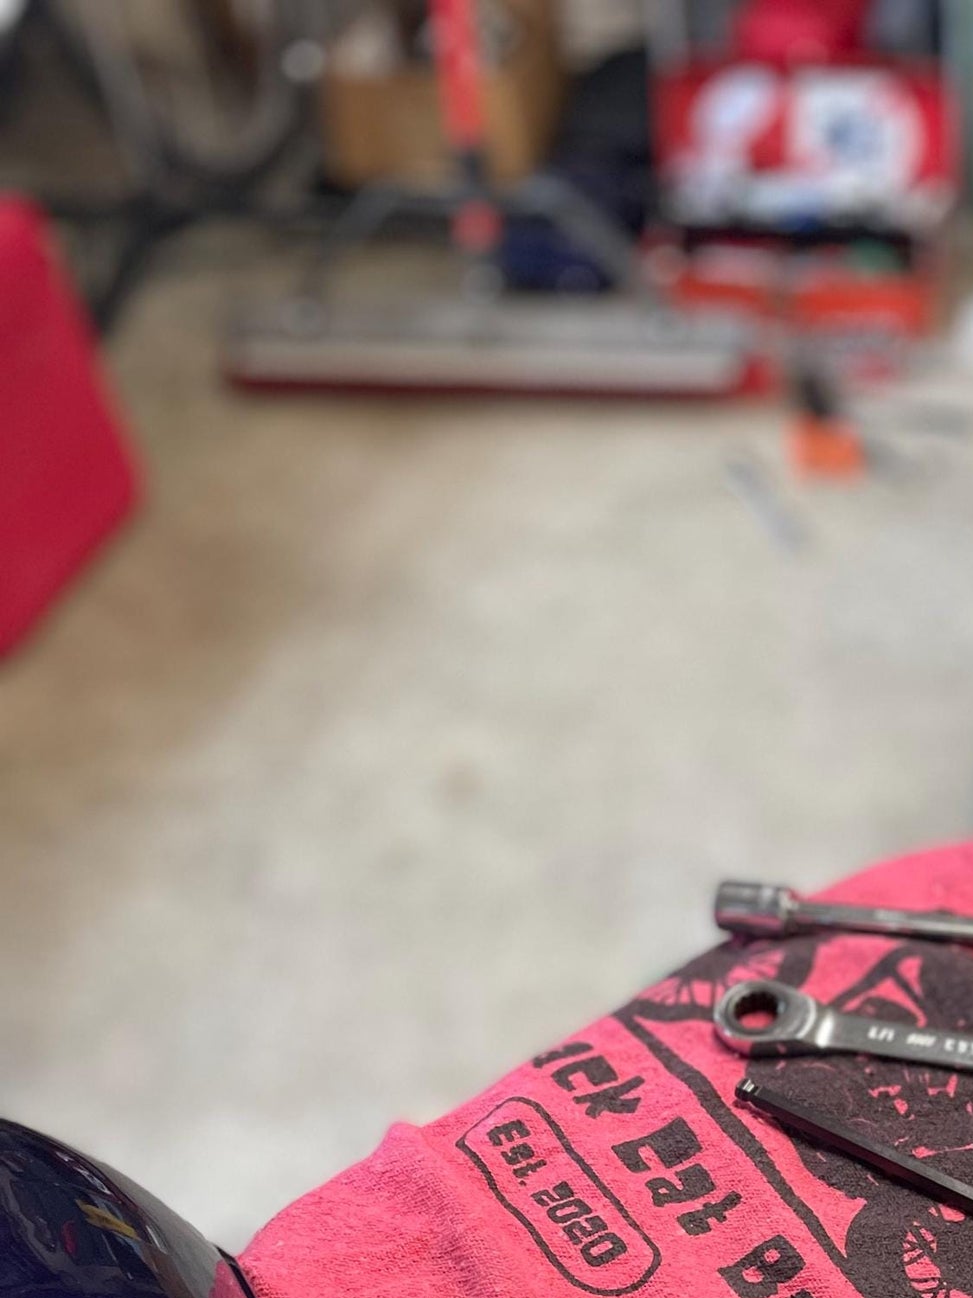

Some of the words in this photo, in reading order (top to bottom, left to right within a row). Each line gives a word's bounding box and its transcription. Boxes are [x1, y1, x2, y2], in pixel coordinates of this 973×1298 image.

[486, 1119, 548, 1186] Est.
[530, 1180, 628, 1267] 2020
[611, 1117, 742, 1236] Cat
